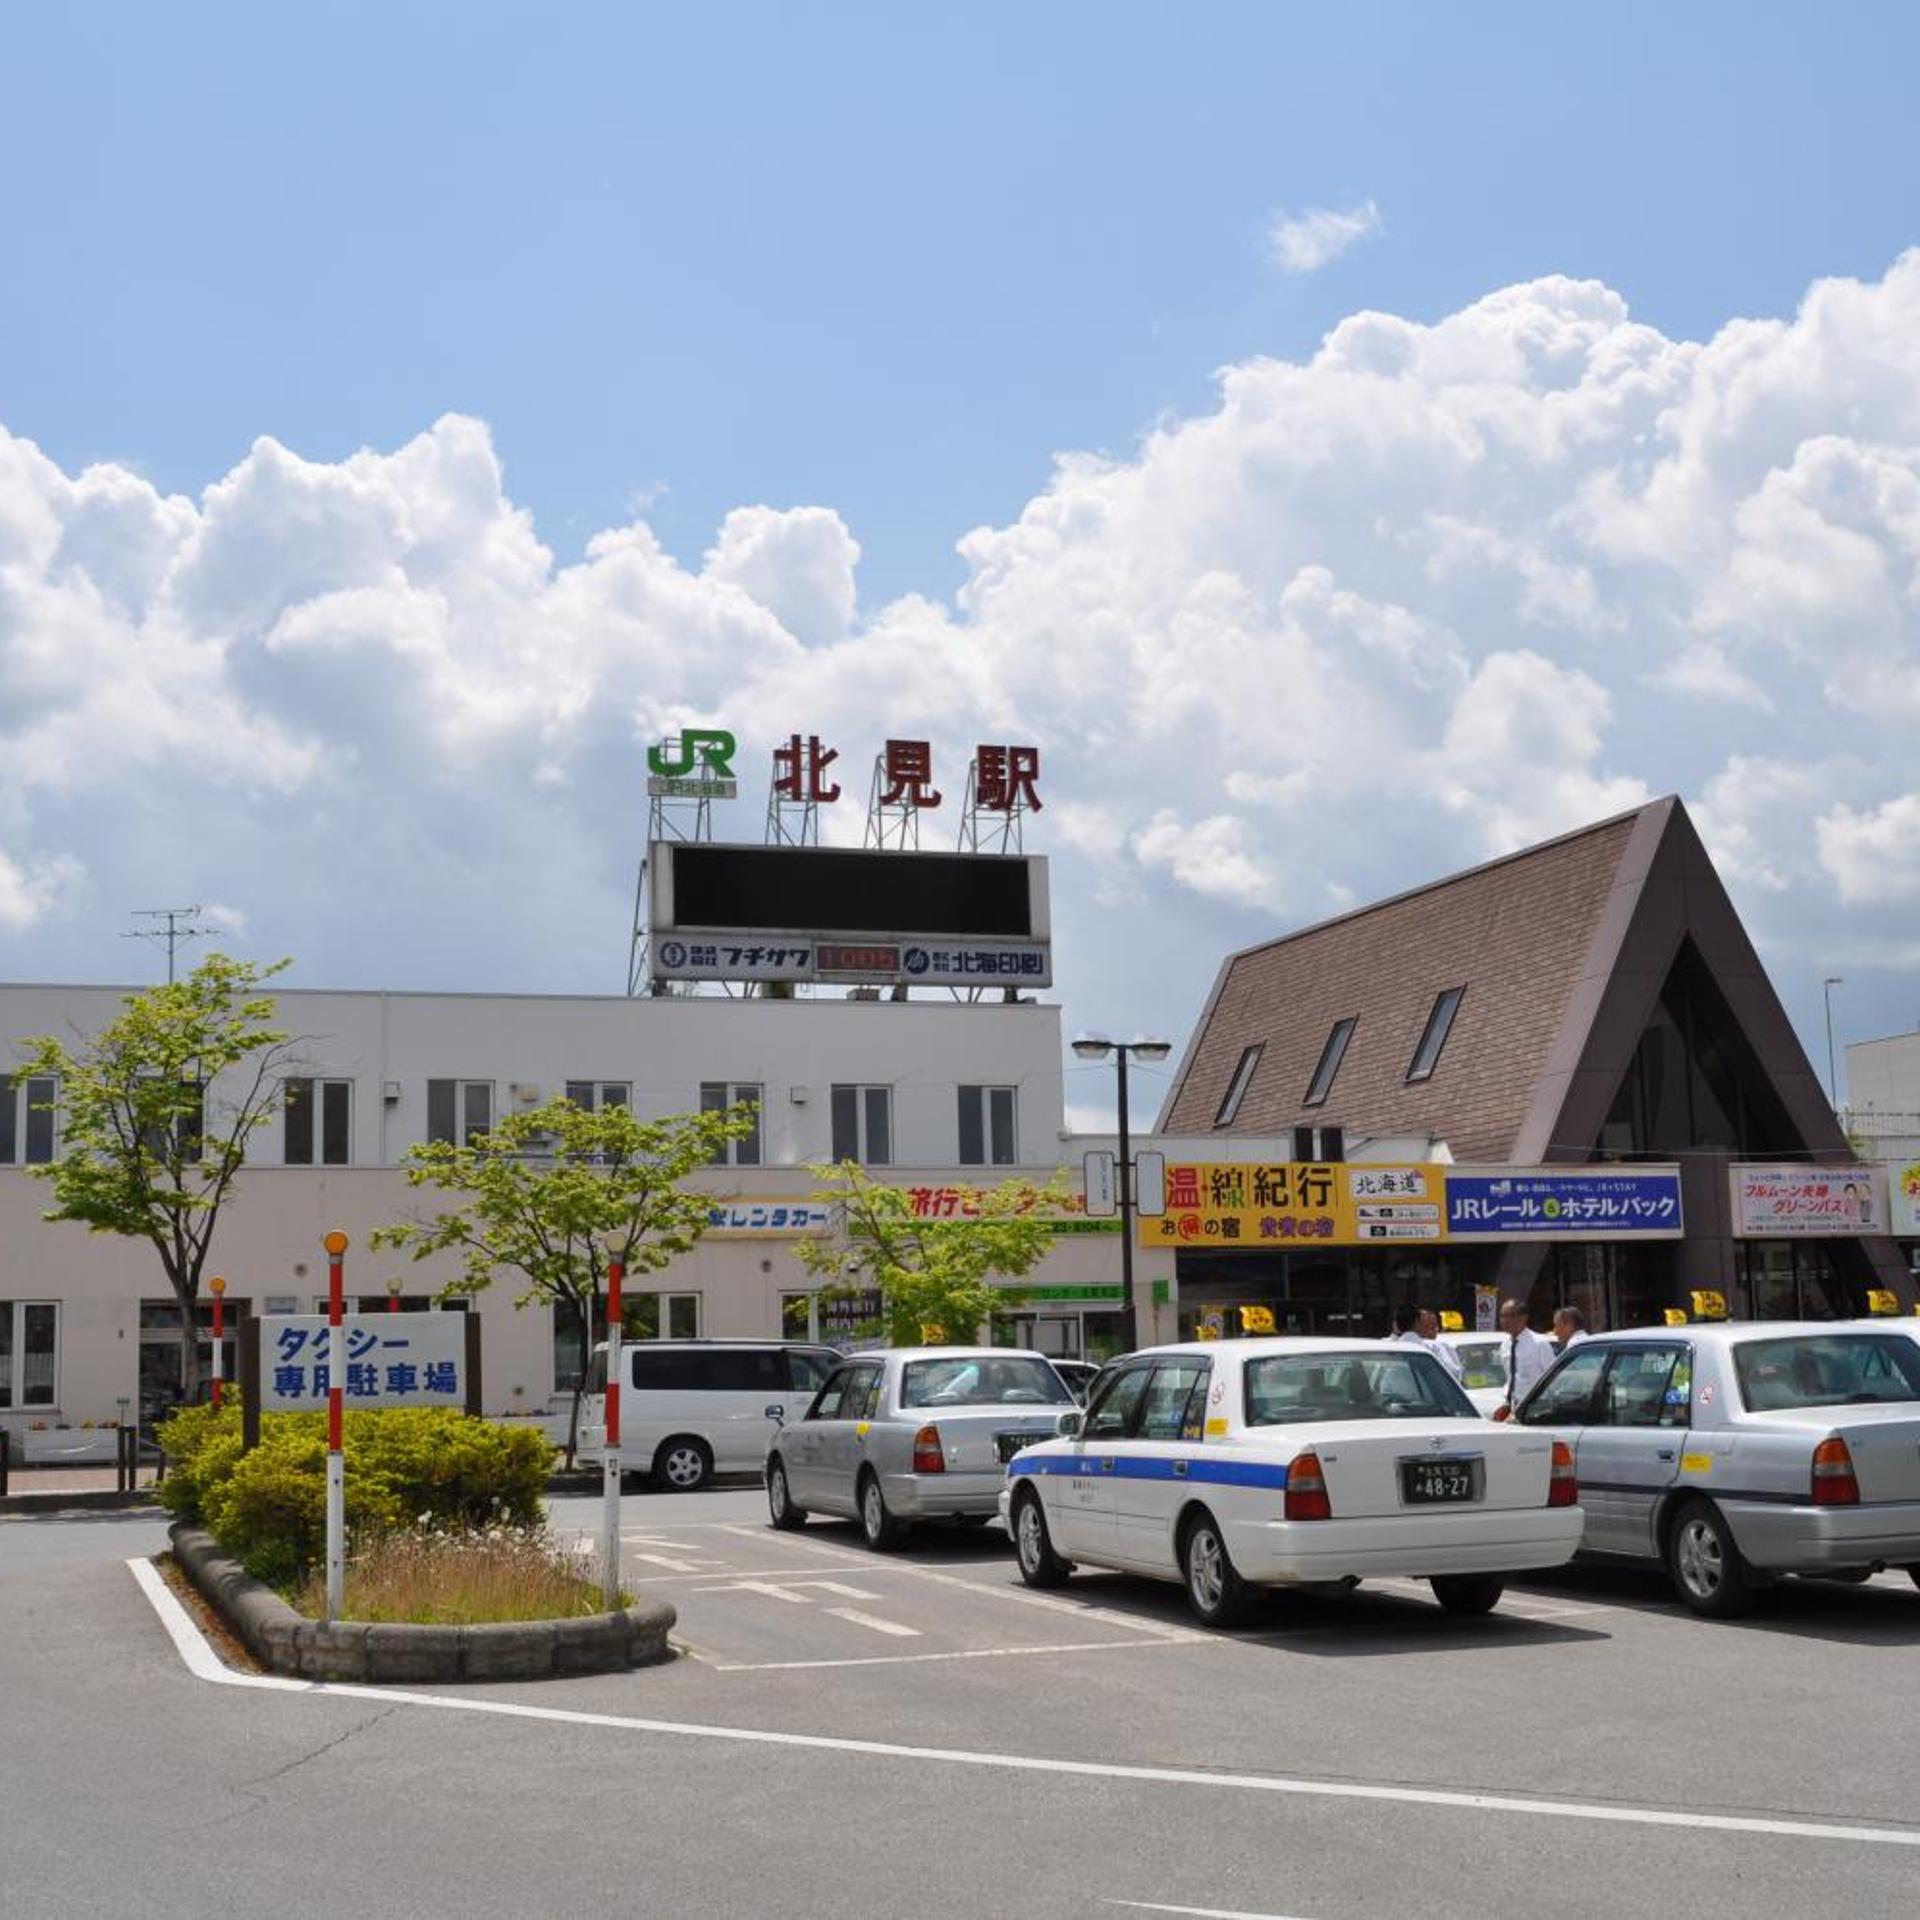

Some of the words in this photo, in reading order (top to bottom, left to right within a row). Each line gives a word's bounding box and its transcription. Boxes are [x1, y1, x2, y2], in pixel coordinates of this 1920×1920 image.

[647, 729, 736, 777] JR
[773, 734, 1042, 812] 北見駅
[952, 952, 1043, 974] 北海印刷
[1355, 1172, 1418, 1194] 北海道
[273, 1361, 457, 1398] 専用駐車場
[1425, 1476, 1469, 1497] 48-27
